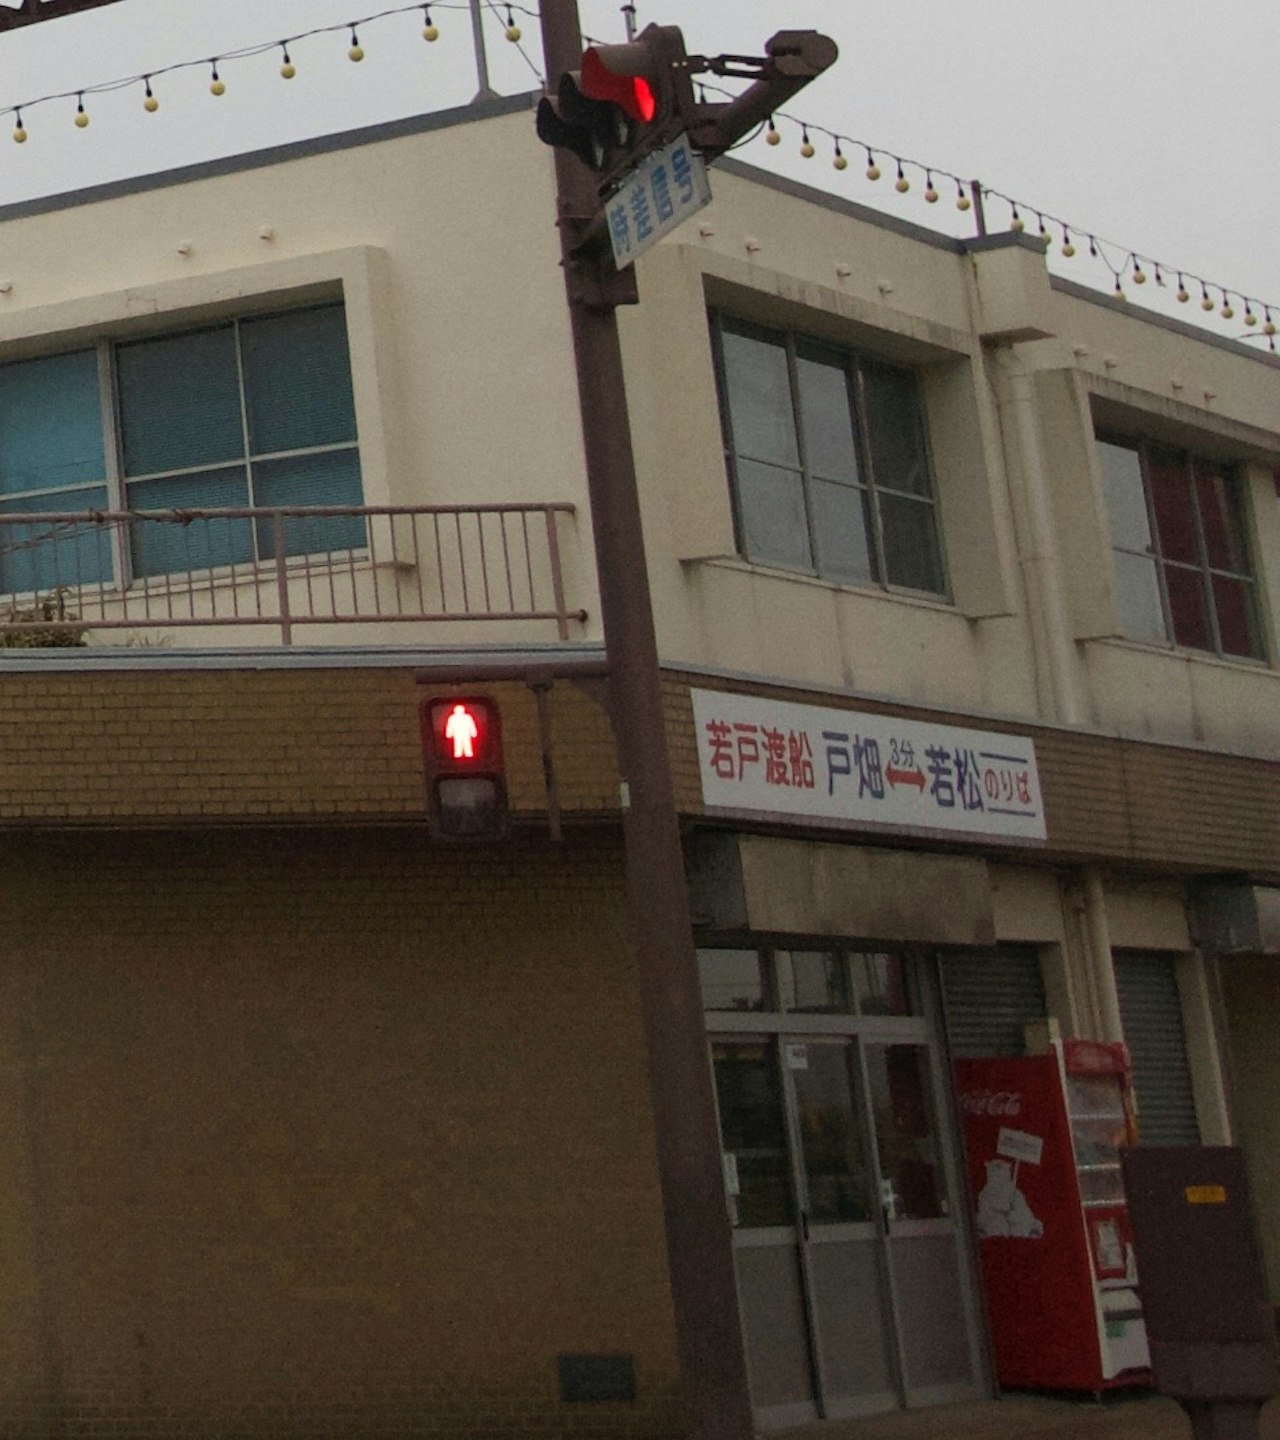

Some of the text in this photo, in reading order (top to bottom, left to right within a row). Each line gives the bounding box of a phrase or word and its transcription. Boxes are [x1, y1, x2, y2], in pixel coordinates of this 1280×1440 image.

[705, 719, 1032, 813] 若戸渡船 戸畑 3分 若松 のりば
